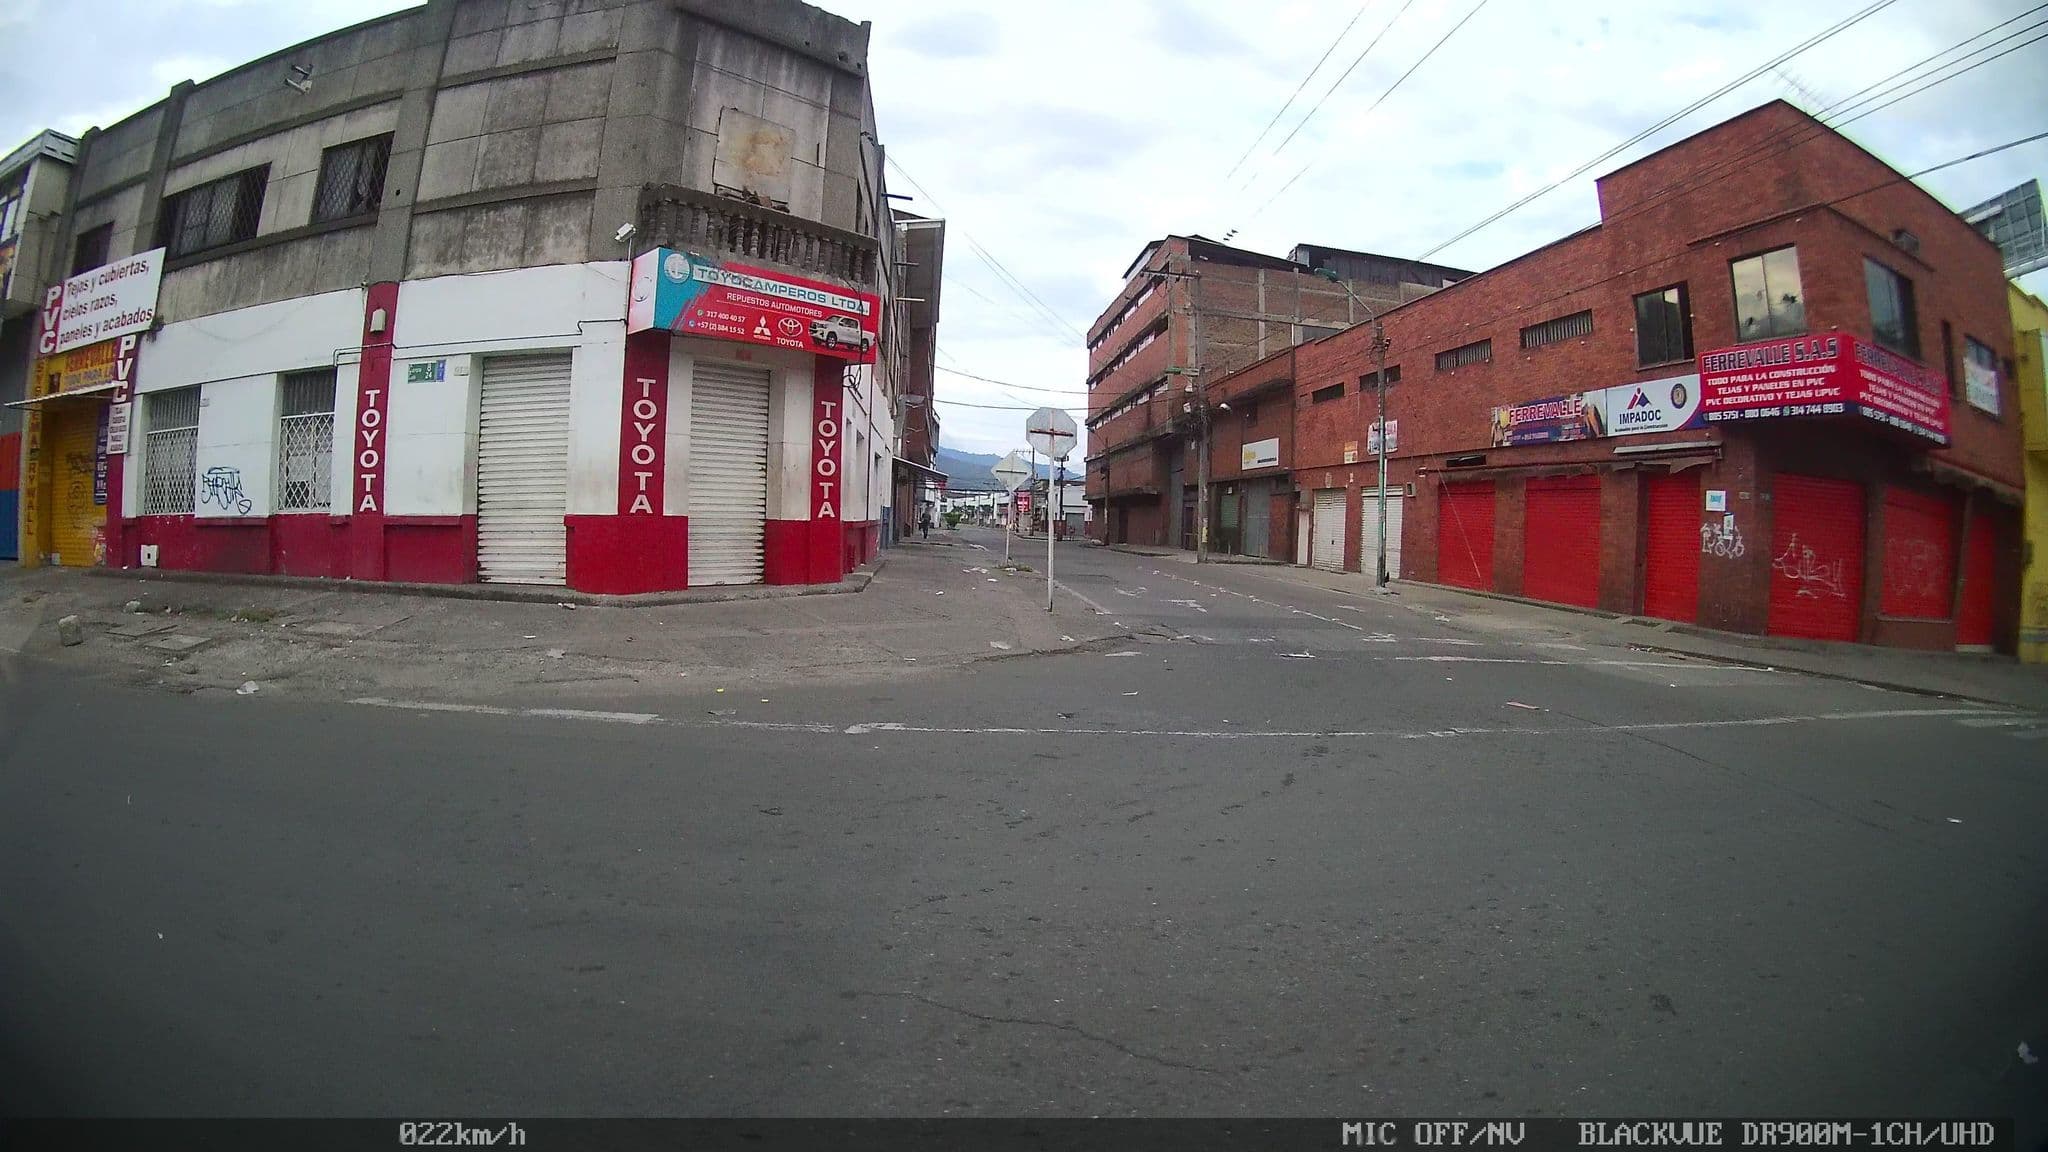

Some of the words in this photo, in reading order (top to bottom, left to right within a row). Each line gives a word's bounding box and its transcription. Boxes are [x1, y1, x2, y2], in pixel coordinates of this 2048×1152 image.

[67, 280, 89, 298] Tejas
[98, 259, 150, 286] cubiertas,
[697, 267, 827, 303] TOYOCAMPEROS
[90, 293, 118, 313] razos,
[726, 292, 770, 308] REPUESTOS
[771, 300, 823, 319] AUTOMOTORES
[60, 323, 93, 345] paneles
[102, 306, 153, 332] acabados
[776, 336, 805, 349] TOYOTA
[1702, 343, 1791, 375] FERREVALLE
[1707, 376, 1729, 386] TODO
[1730, 374, 1754, 384] PARA
[1755, 372, 1768, 381] LA
[1717, 385, 1742, 395] TEJAS
[1752, 381, 1790, 392] PANELES
[1791, 379, 1805, 388] EN
[1806, 377, 1825, 387] PVC
[1705, 397, 1722, 406] PVC
[1723, 393, 1775, 405] DECORATIVO
[1785, 389, 1813, 400] TEJAS
[1508, 398, 1583, 425] FERREVALLE
[1619, 409, 1662, 425] IMPADOC
[359, 389, 381, 512] TOYOTA
[629, 377, 658, 514] TOYOTA
[817, 400, 838, 518] TOYOTA
